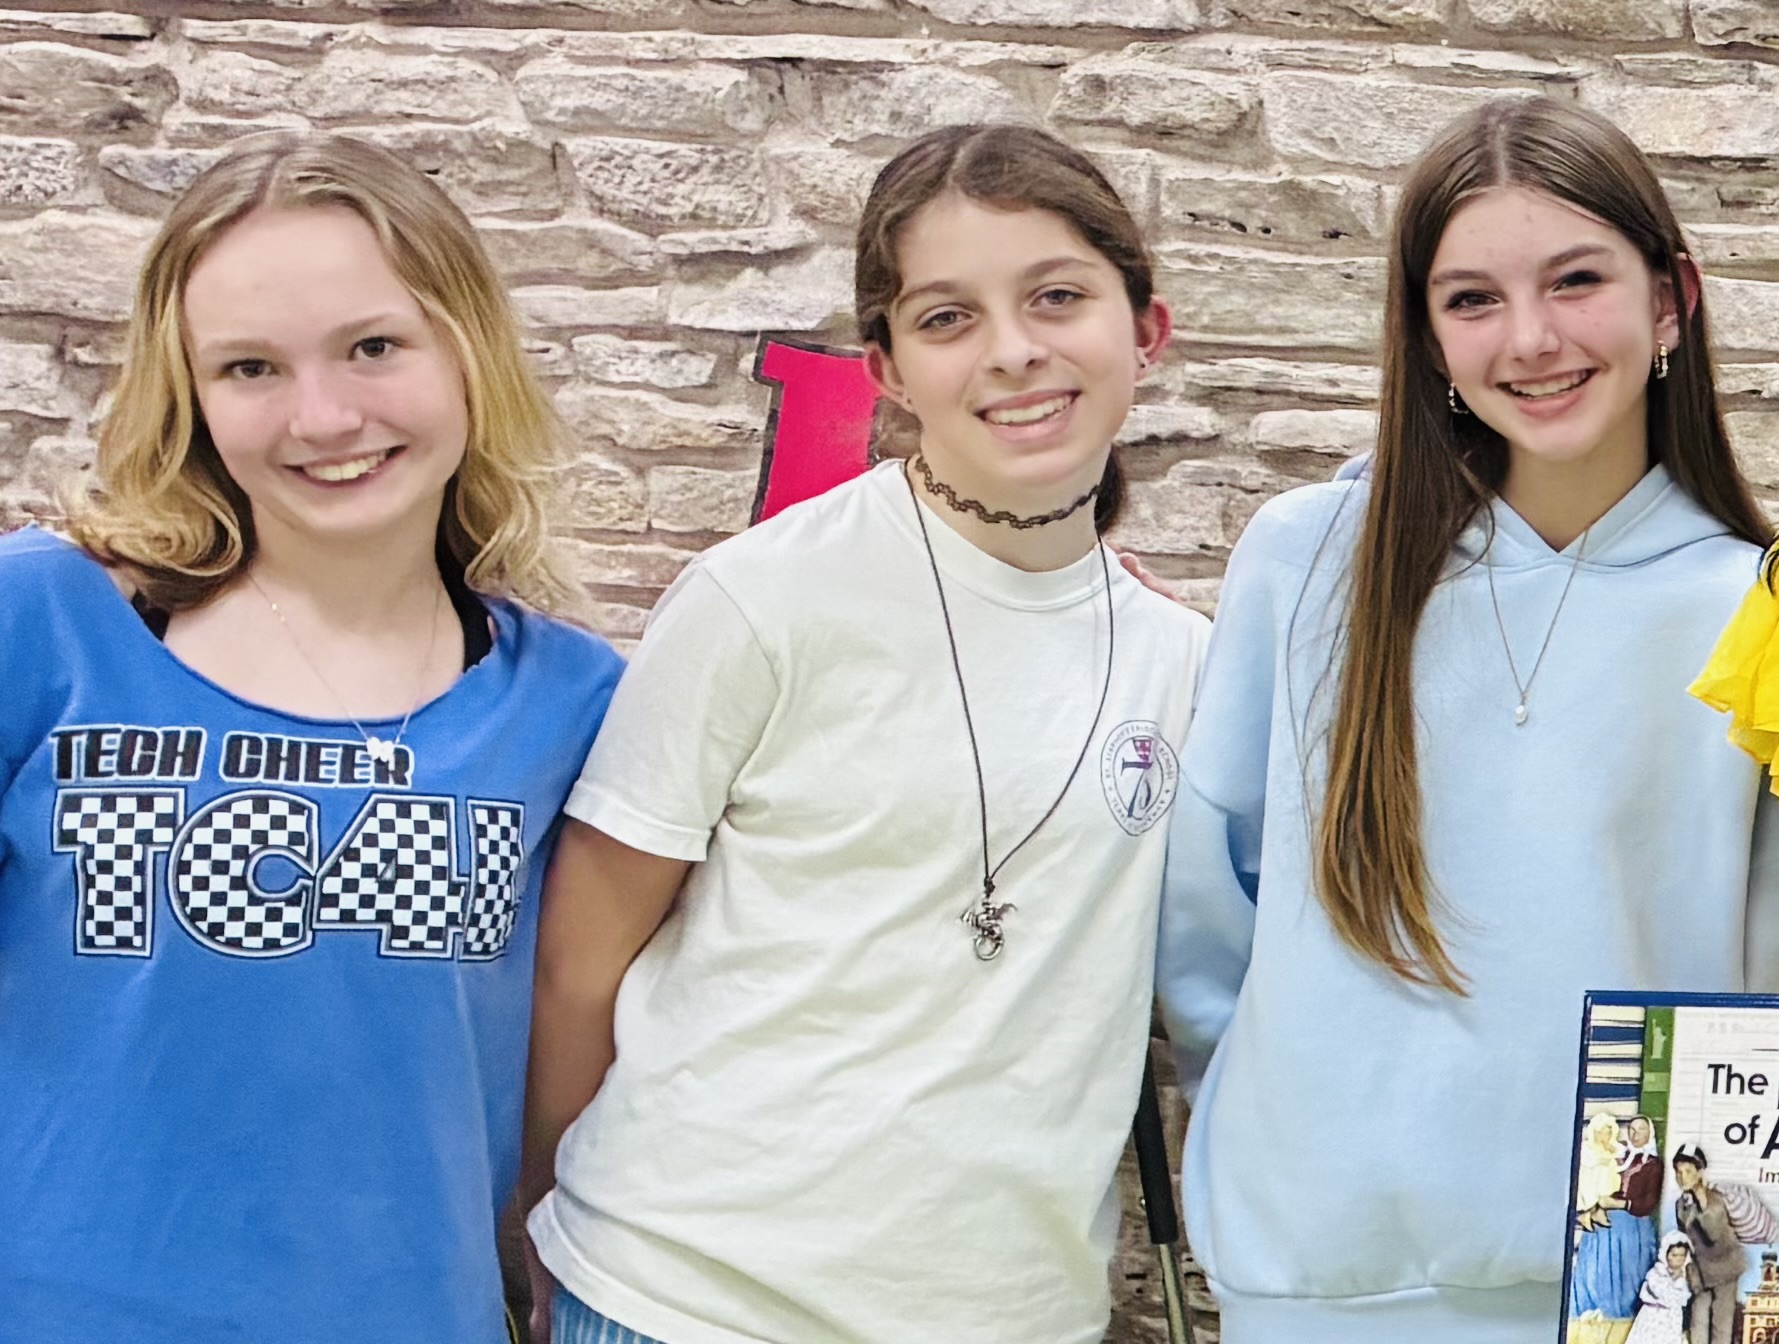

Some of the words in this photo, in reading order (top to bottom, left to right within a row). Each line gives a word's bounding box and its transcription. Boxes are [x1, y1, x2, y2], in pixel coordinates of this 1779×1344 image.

[50, 724, 207, 781] TECH
[219, 730, 415, 789] CHEER
[1707, 1063, 1769, 1096] The
[1724, 1114, 1760, 1145] of
